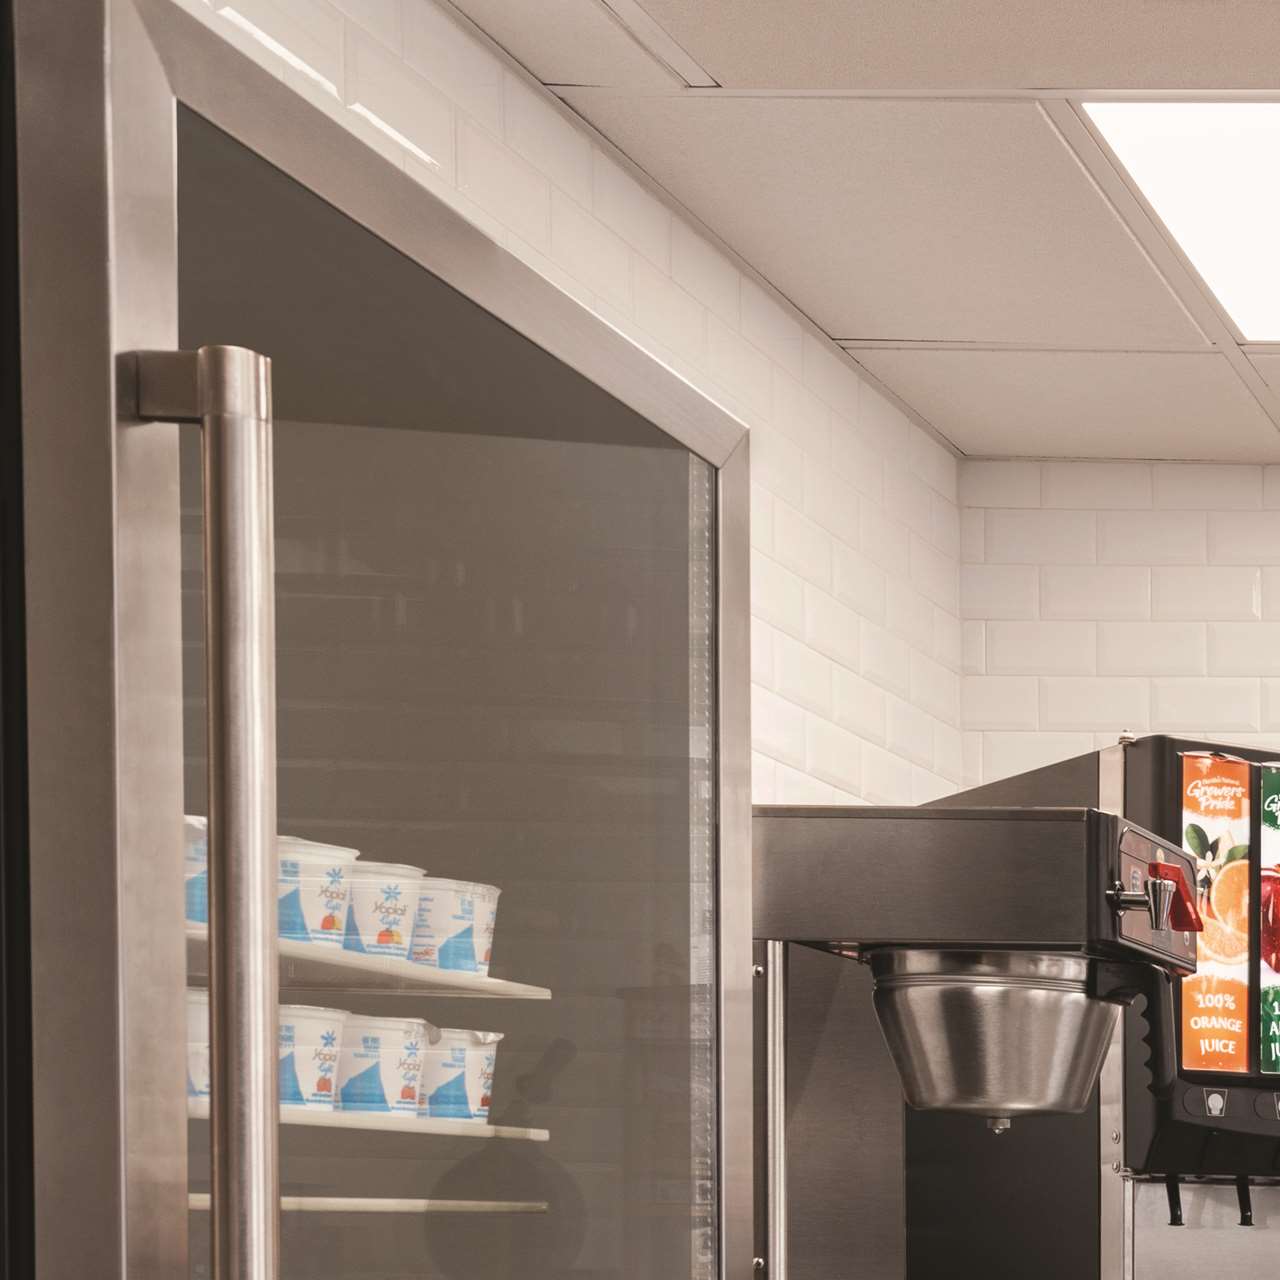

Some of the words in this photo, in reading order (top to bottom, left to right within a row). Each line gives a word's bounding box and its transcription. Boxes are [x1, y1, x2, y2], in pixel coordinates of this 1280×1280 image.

[1200, 797, 1236, 811] Pride
[1197, 993, 1236, 1010] 100%
[1189, 1015, 1243, 1032] ORANGE
[1200, 1039, 1237, 1056] JUICE
